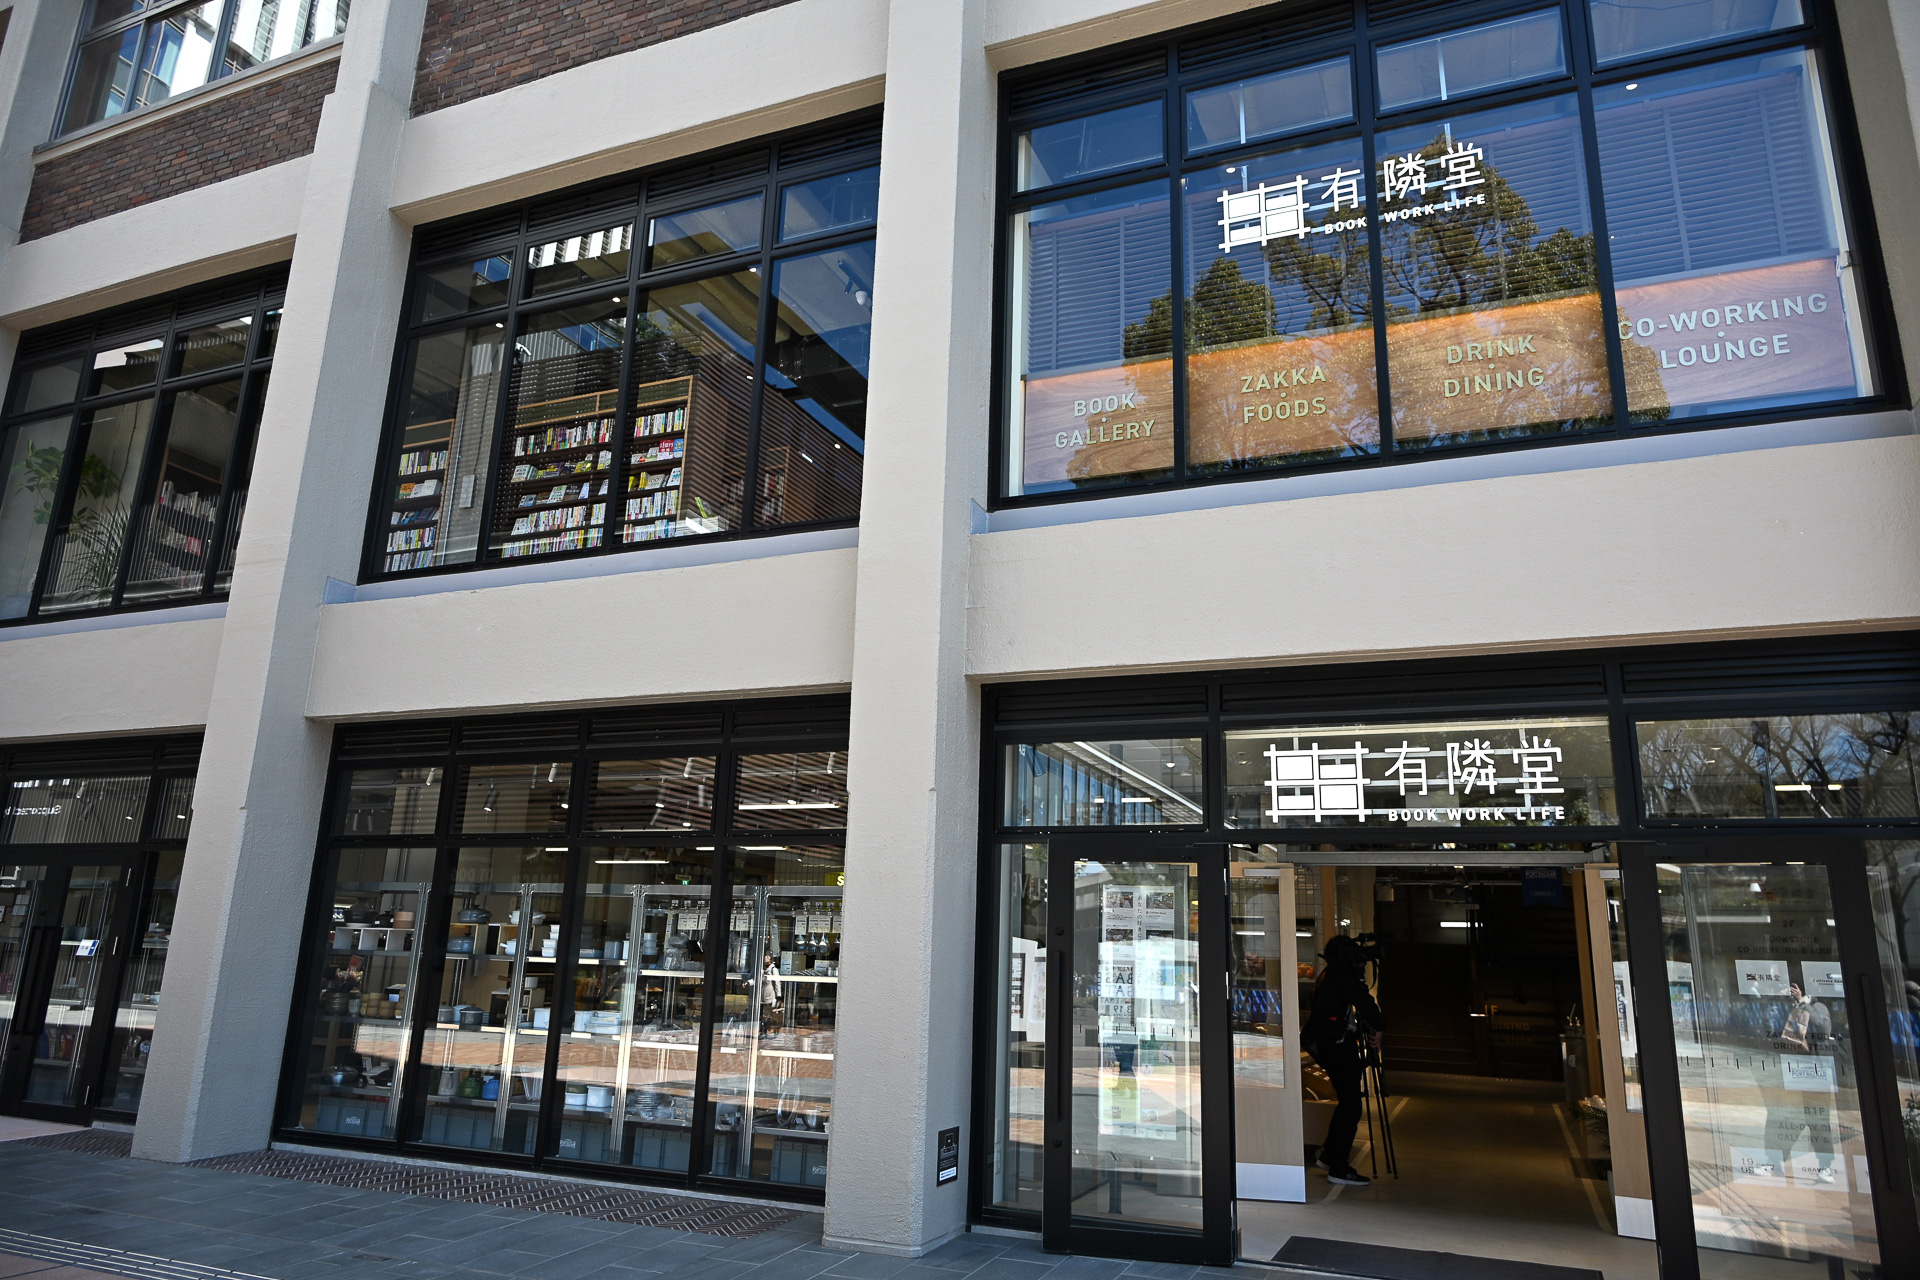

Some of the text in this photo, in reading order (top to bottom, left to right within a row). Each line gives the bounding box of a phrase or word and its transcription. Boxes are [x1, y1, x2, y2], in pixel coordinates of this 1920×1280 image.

[1320, 141, 1486, 213] 有隣堂
[1324, 193, 1486, 235] BOOK WORK LIFE
[1618, 292, 1828, 341] CO-WORKING
[1445, 333, 1537, 366] DRINK
[1660, 333, 1791, 370] LOUNGE
[1240, 365, 1327, 394] ZAKKA
[1443, 366, 1545, 399] DINING
[1073, 392, 1136, 418] BOOK
[1243, 396, 1327, 424] FOODS
[1054, 419, 1155, 449] GALLERY
[1384, 735, 1565, 797] 有隣堂
[1388, 806, 1565, 822] BOOK WORK LIFE
[1782, 919, 1796, 928] 2F
[1773, 1041, 1839, 1052] DRINK STAND
[1803, 1106, 1825, 1116] B1F
[1777, 1133, 1819, 1144] GALLERY
[1833, 1137, 1860, 1146] SHOP
[1778, 1122, 1818, 1132] ALL-DAY
